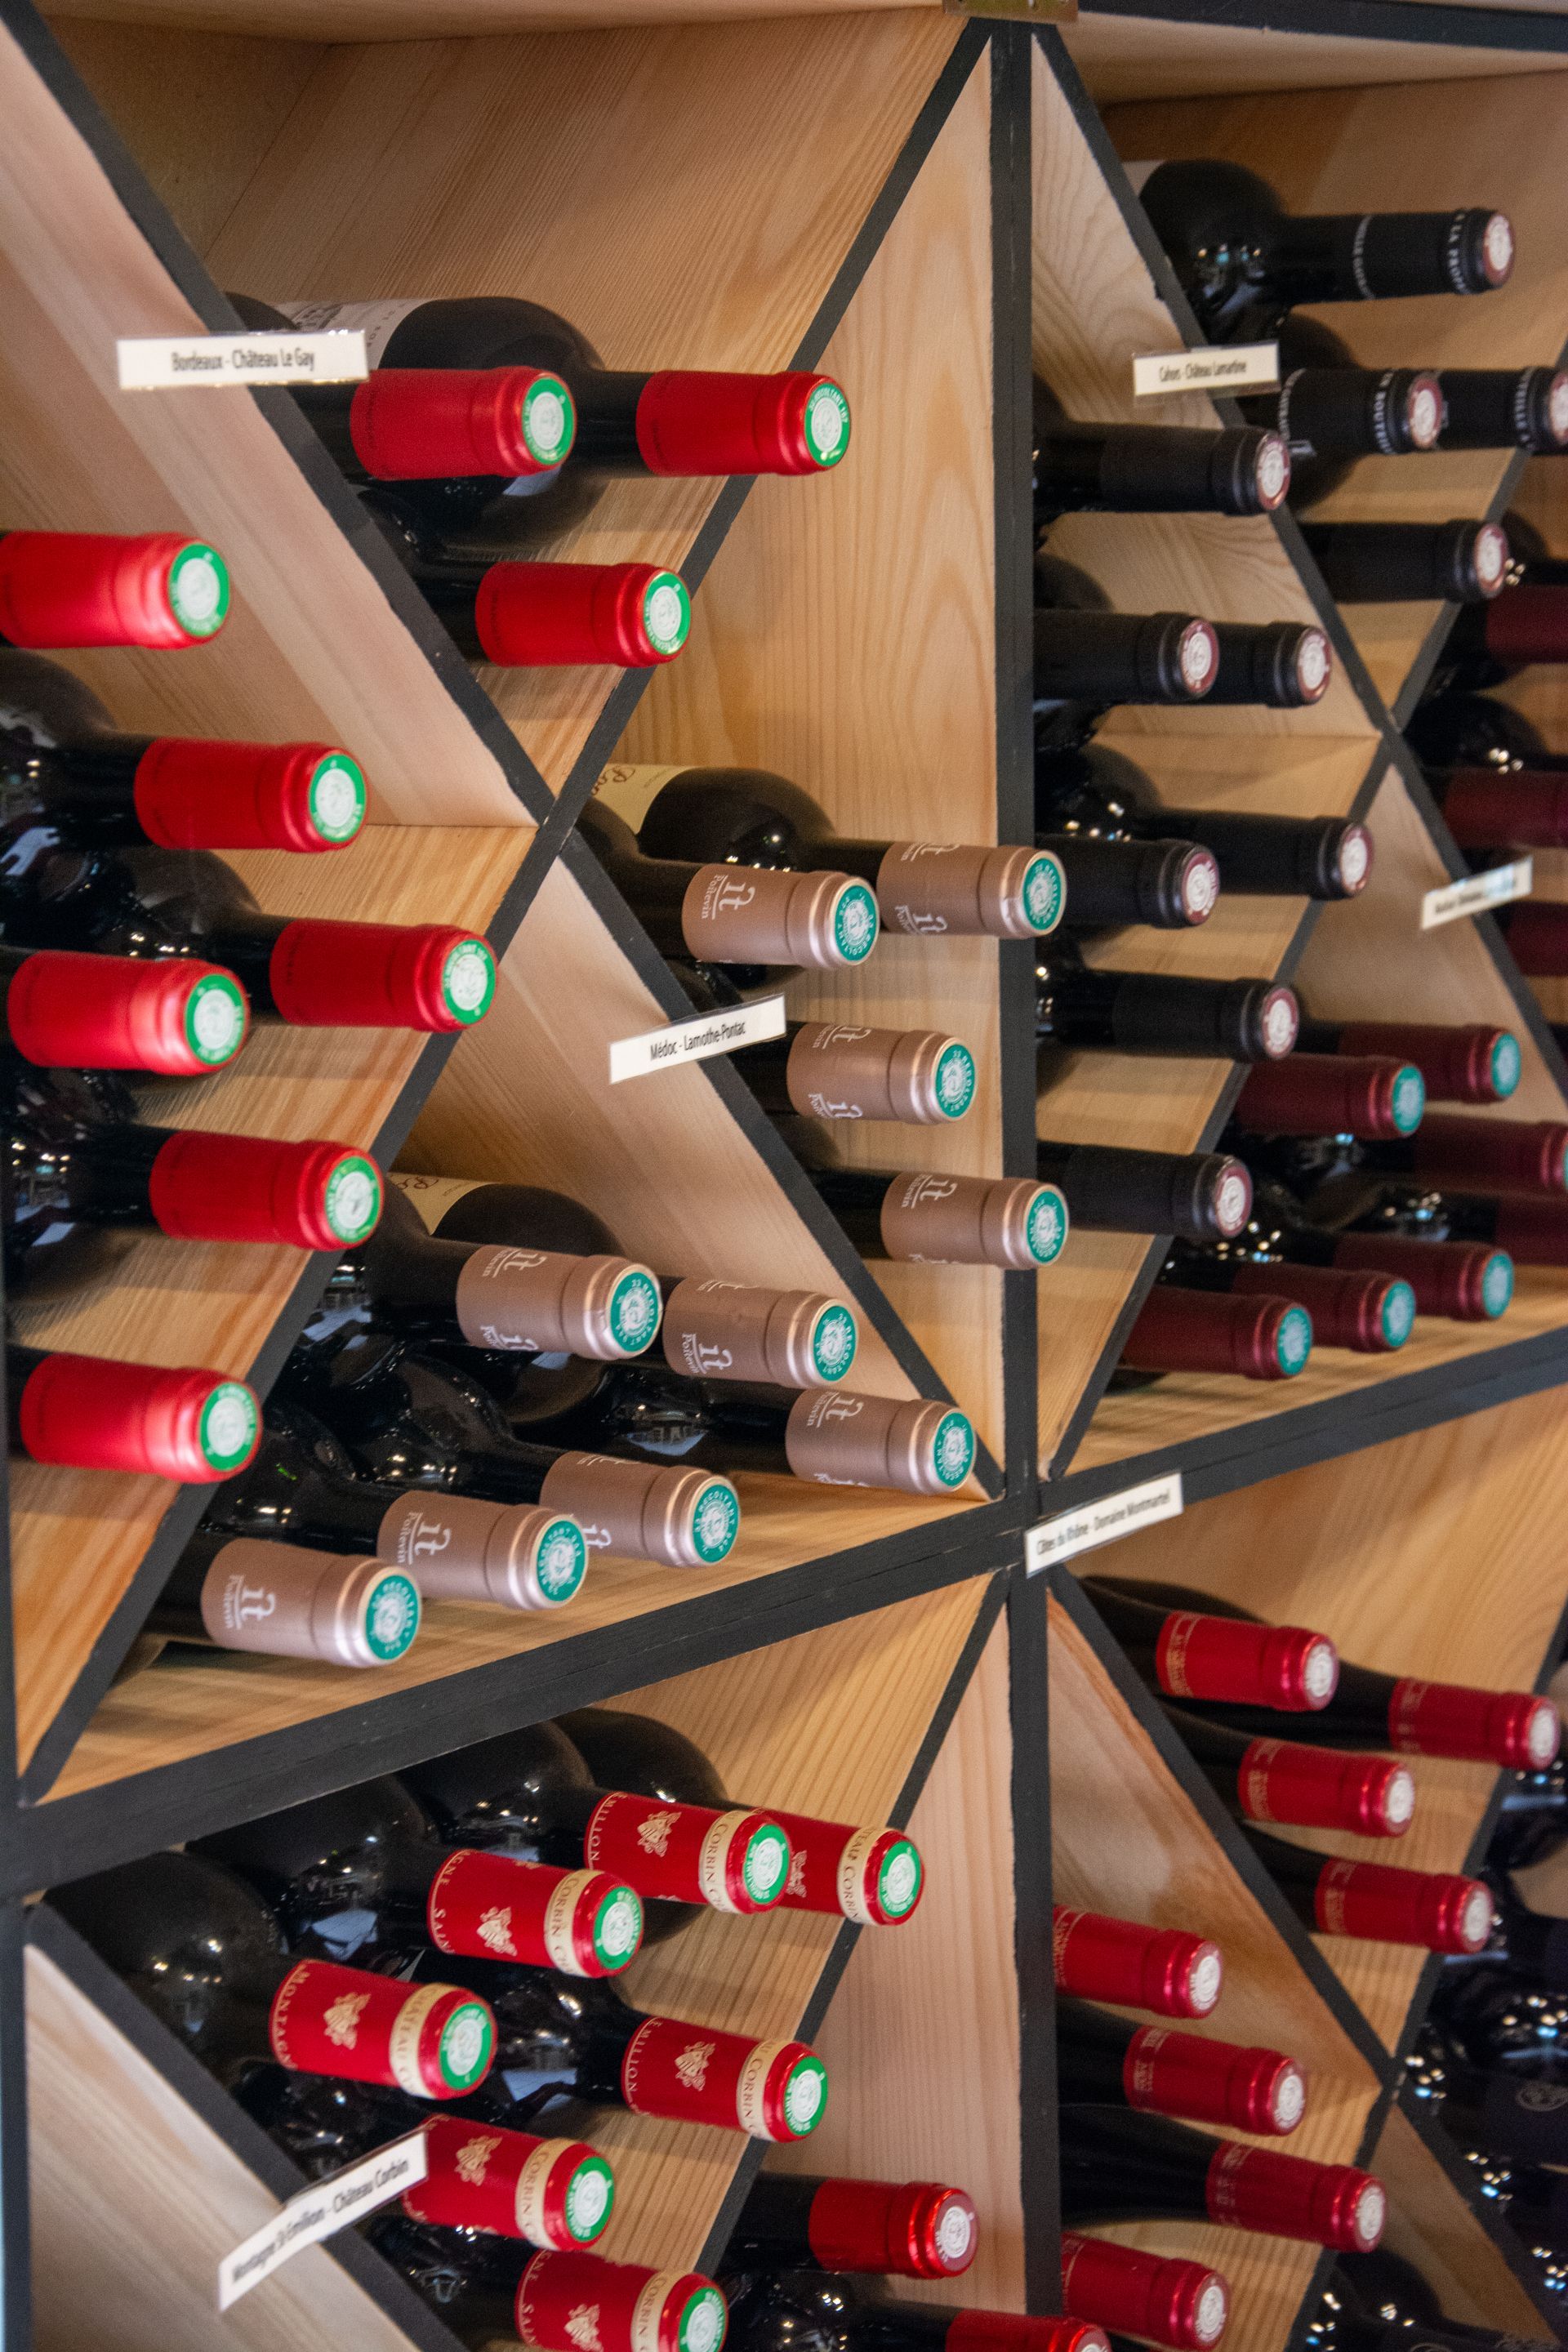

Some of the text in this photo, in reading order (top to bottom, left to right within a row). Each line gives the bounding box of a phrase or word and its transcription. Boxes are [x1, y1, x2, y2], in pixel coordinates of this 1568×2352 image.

[171, 350, 223, 372] Bordeaux
[232, 348, 278, 369] Château
[280, 347, 292, 367] Le
[295, 346, 315, 372] Gay
[702, 874, 725, 920] Poitevin
[650, 1038, 678, 1061] Médoc
[706, 1823, 728, 1882] CORBIN
[552, 1878, 579, 1936] CORBIN
[742, 2057, 763, 2118] CORBIN
[374, 2158, 409, 2189] Corbin
